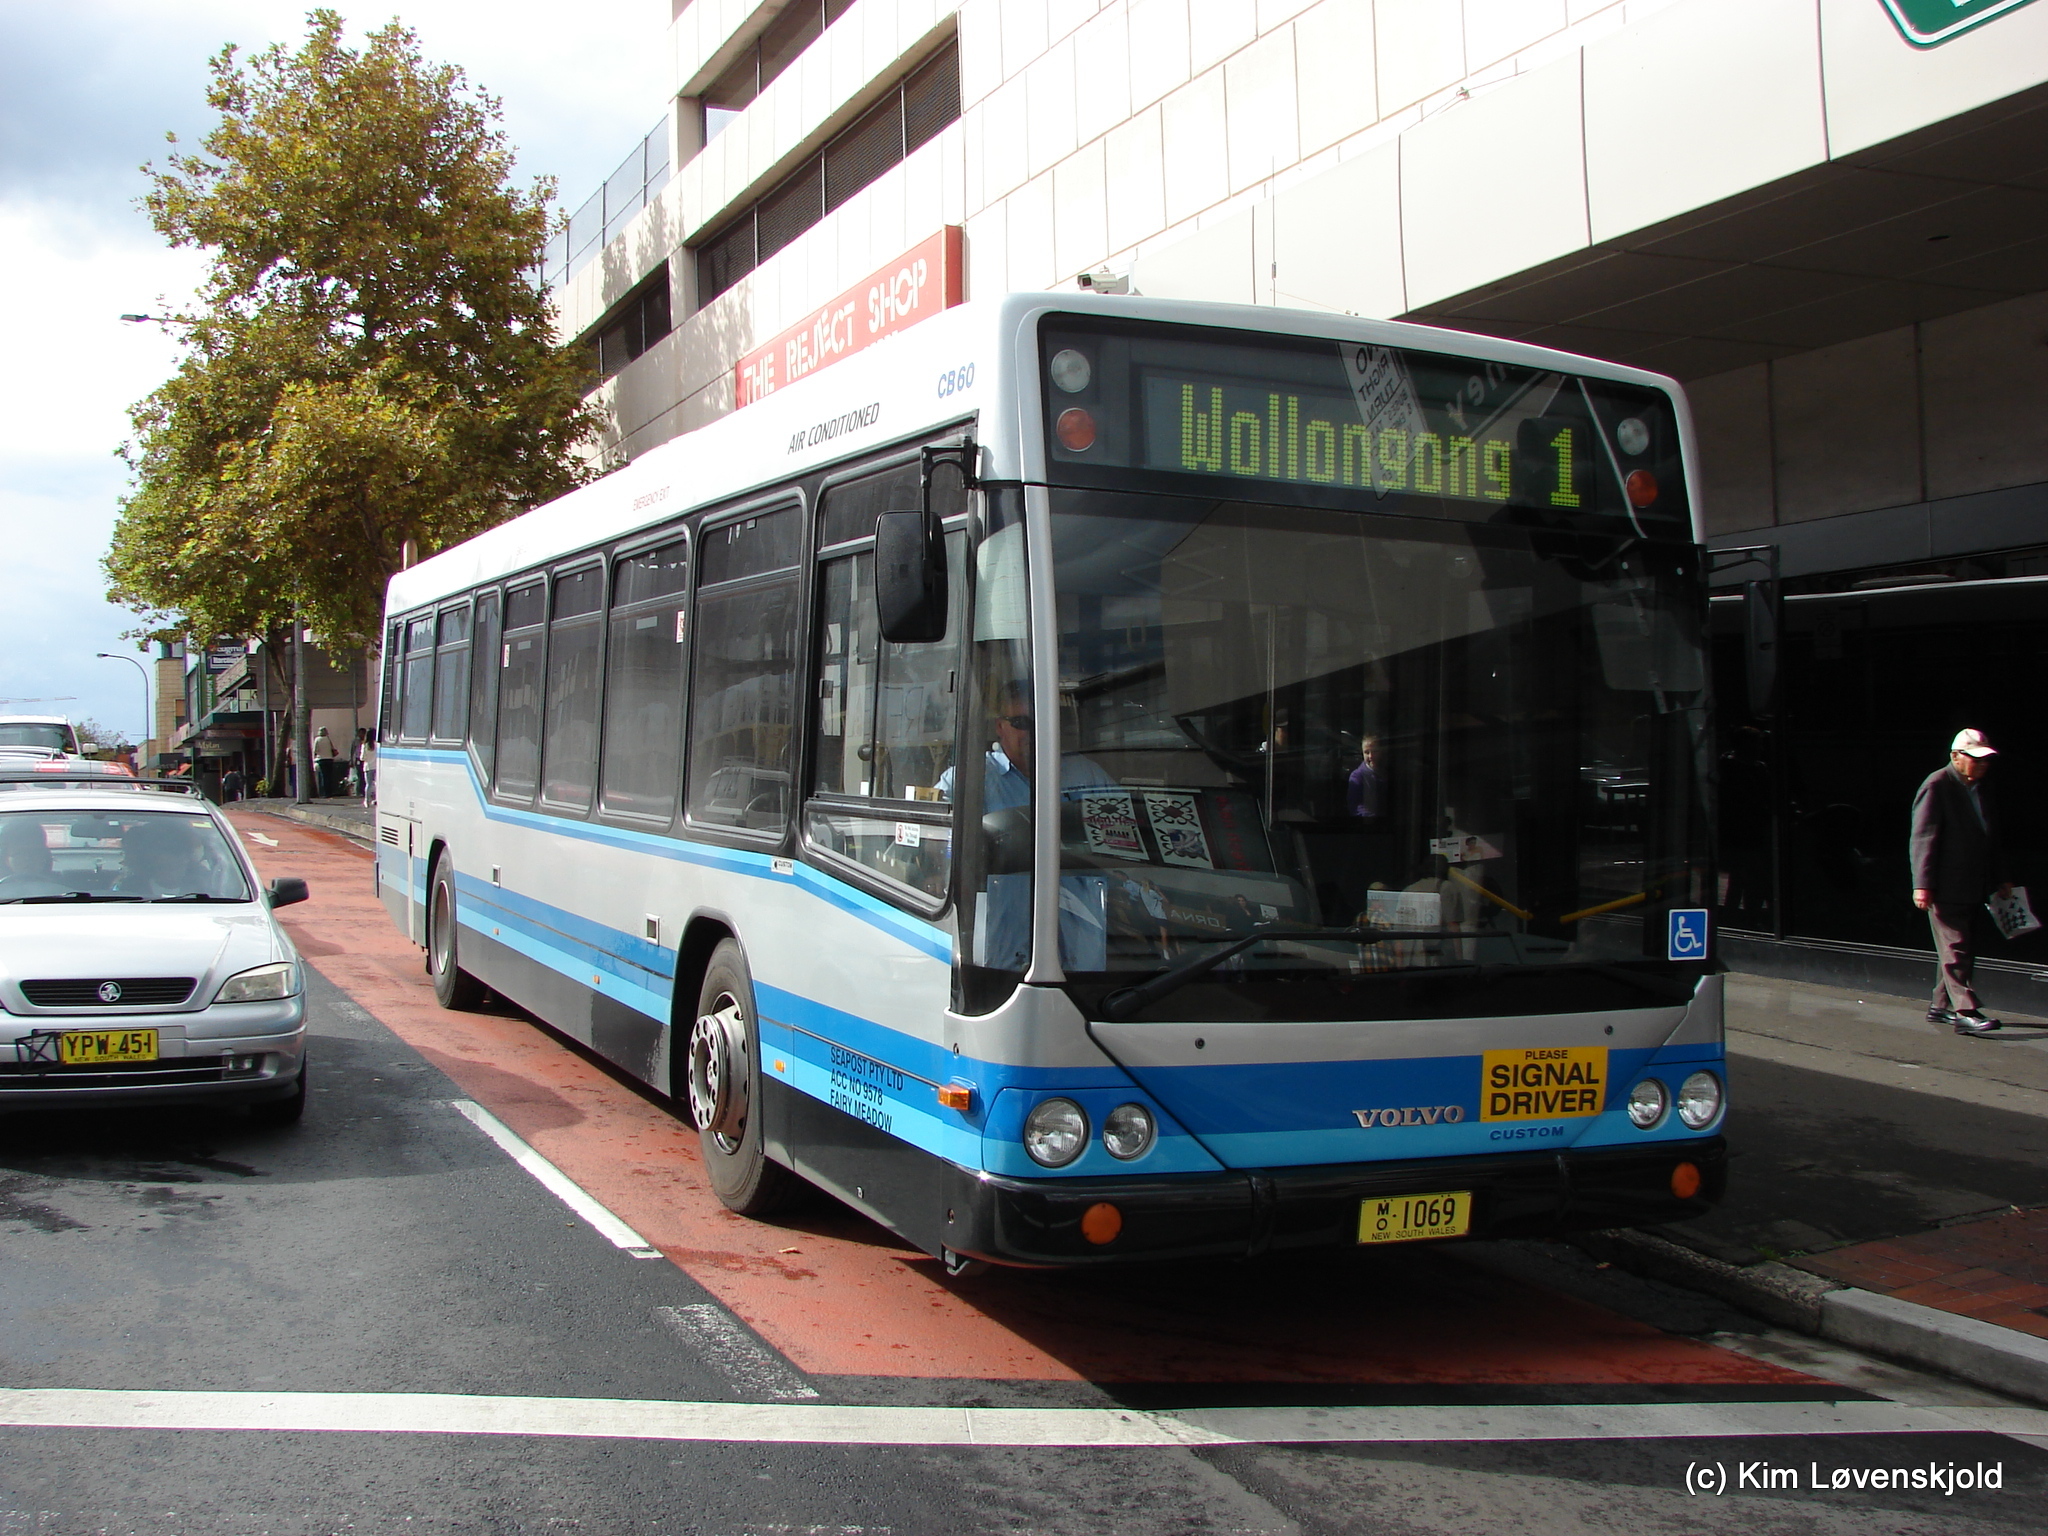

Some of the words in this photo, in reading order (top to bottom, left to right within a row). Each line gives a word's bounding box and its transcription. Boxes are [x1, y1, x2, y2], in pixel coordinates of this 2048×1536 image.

[744, 353, 775, 405] THE
[785, 301, 856, 382] REJECT
[868, 258, 927, 333] SHOP
[788, 430, 805, 454] AIR
[808, 403, 880, 447] CONDITIONED
[1181, 384, 1510, 501] Wollongong
[1550, 428, 1580, 508] 1
[830, 1046, 867, 1075] SEAPOST
[869, 1060, 886, 1084] PTY
[886, 1069, 904, 1091] LTD
[1525, 1049, 1568, 1061] PLEASE
[830, 1068, 848, 1090] ACC
[849, 1076, 862, 1097] NO
[863, 1082, 884, 1106] 9578
[1490, 1062, 1600, 1089] SIGNAL
[830, 1089, 853, 1115] FAIRY
[854, 1099, 893, 1133] MEADOW
[1352, 1105, 1465, 1128] VOLVO
[1490, 1089, 1597, 1116] DRIVER
[1490, 1126, 1564, 1140] CUSTOM
[1371, 1231, 1391, 1240] NEW
[1395, 1229, 1424, 1239] SOUTH
[1428, 1226, 1456, 1235] WALES
